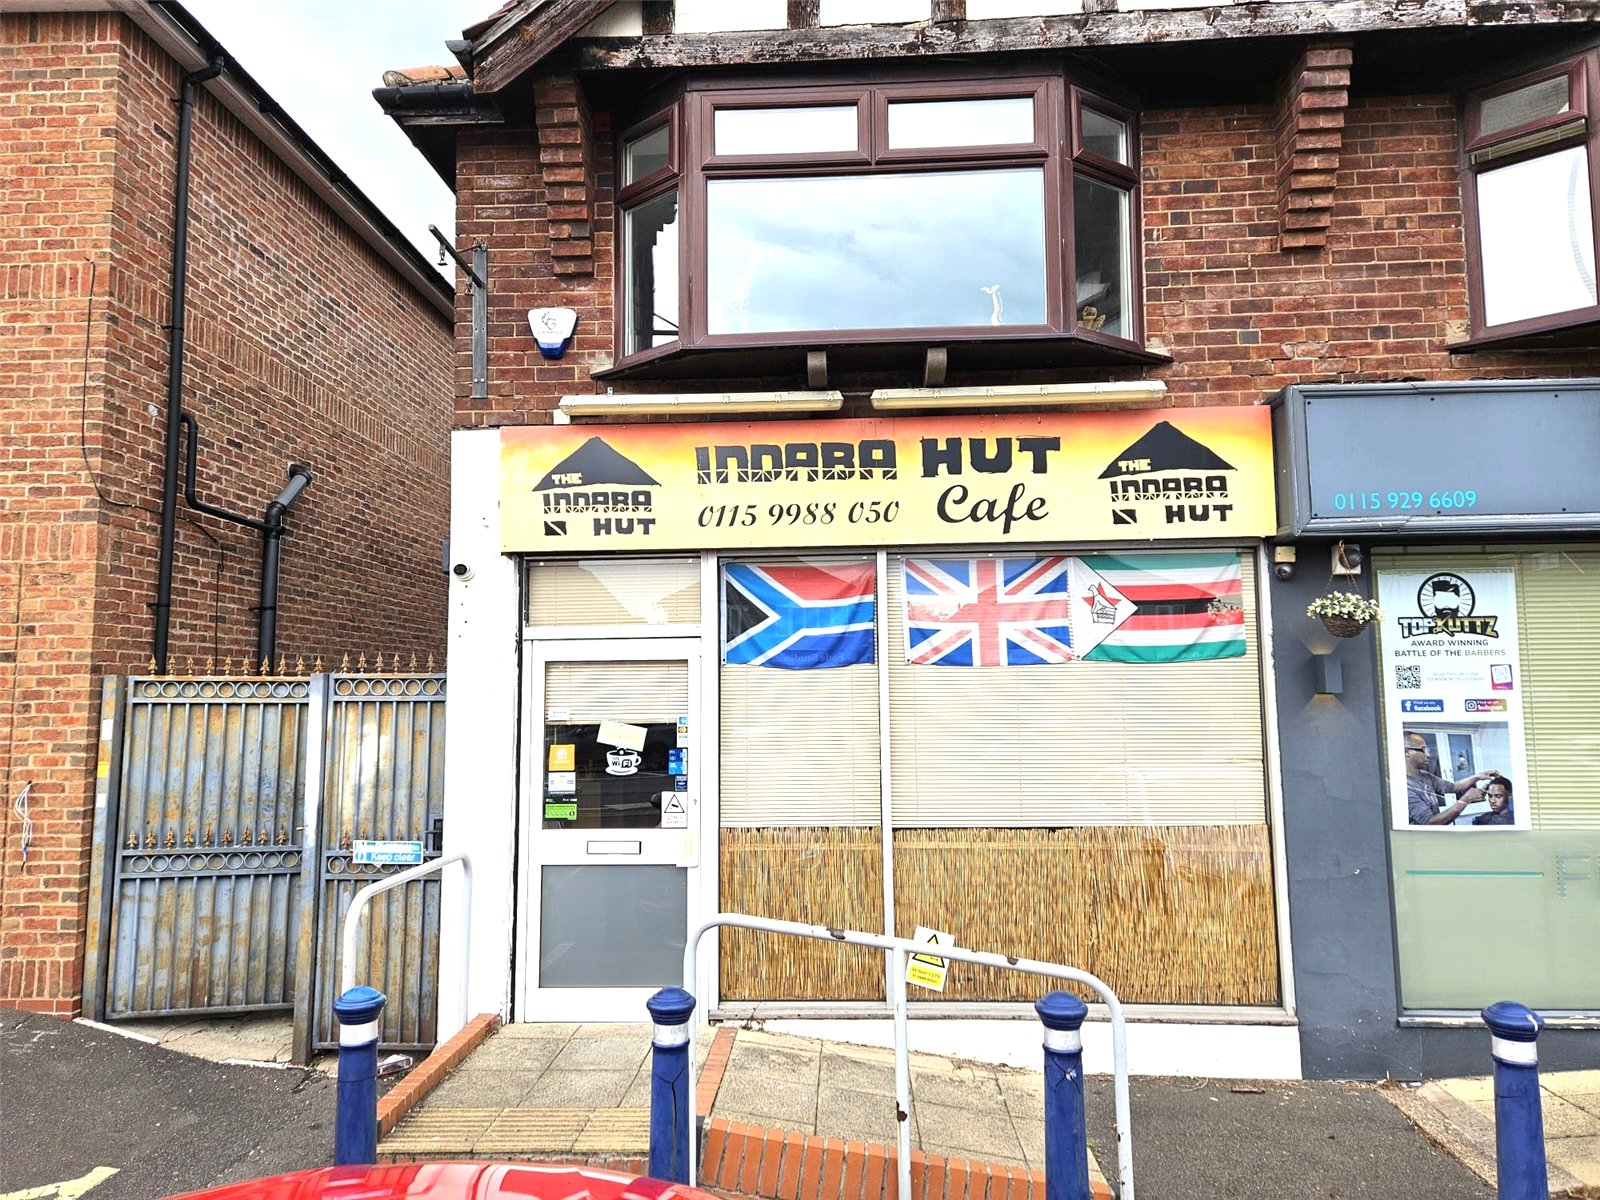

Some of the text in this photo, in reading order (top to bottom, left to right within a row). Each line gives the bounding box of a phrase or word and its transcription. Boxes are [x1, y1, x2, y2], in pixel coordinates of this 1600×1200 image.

[694, 436, 1061, 484] INDABA HUT
[1117, 458, 1152, 472] THE
[551, 472, 583, 486] THE
[1110, 476, 1228, 502] INDABA
[542, 491, 652, 514] INDABA
[936, 482, 1049, 535] Cafe
[1334, 489, 1478, 511] 0115 929 6609
[698, 500, 900, 528] 0115 9988 050
[1165, 504, 1234, 524] HUT
[594, 518, 657, 536] HUT
[1464, 649, 1506, 657] BARBERS
[372, 852, 415, 862] Keep clear
